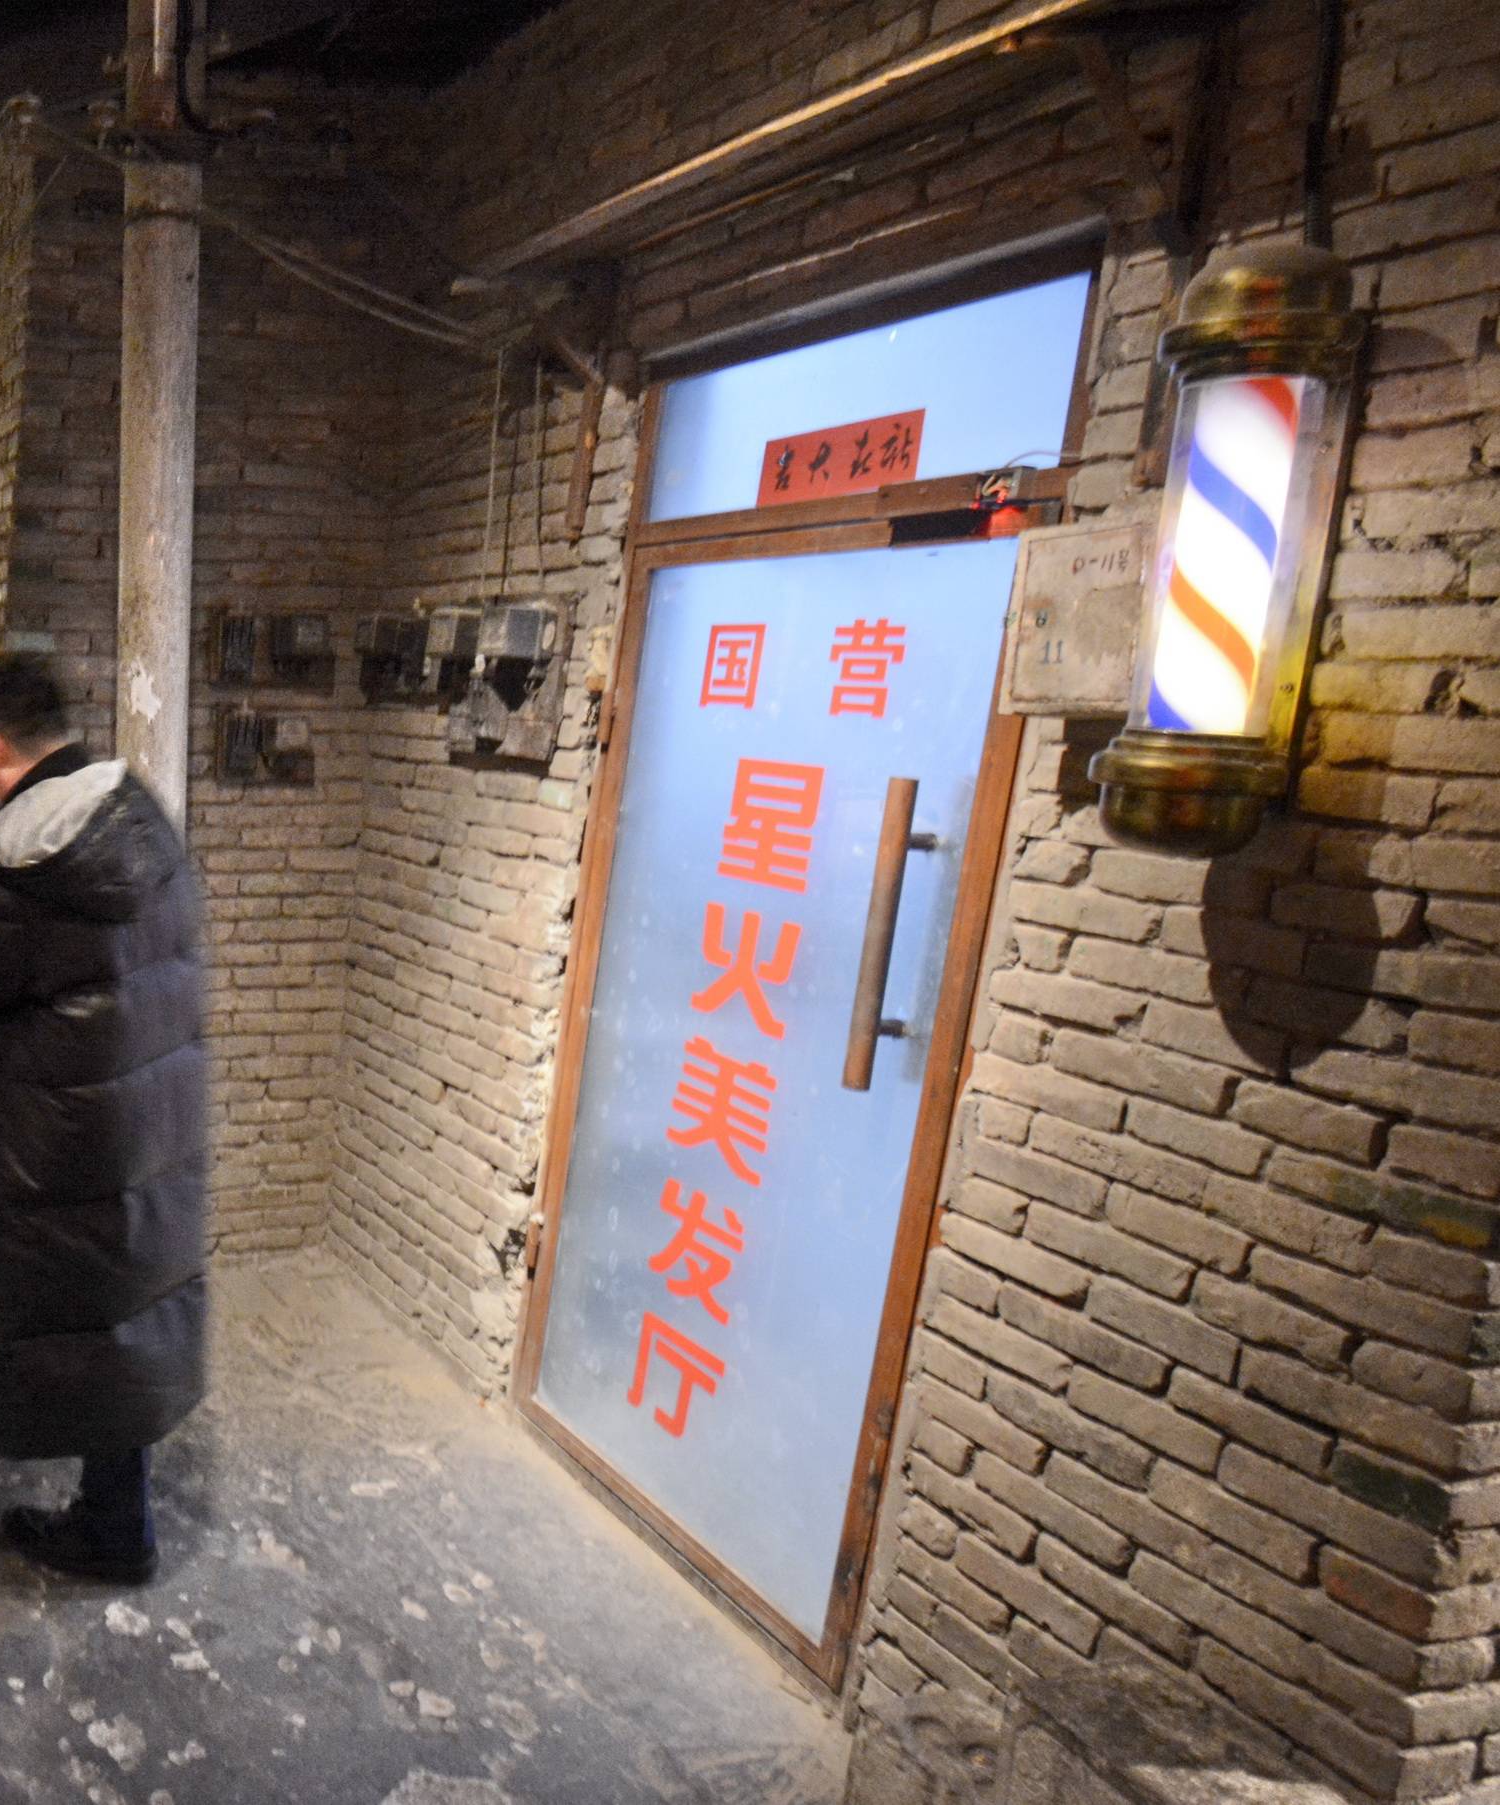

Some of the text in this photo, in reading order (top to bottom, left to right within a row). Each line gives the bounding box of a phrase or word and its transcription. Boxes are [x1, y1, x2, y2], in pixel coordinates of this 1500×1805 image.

[626, 758, 825, 1438] 星火美发厅
